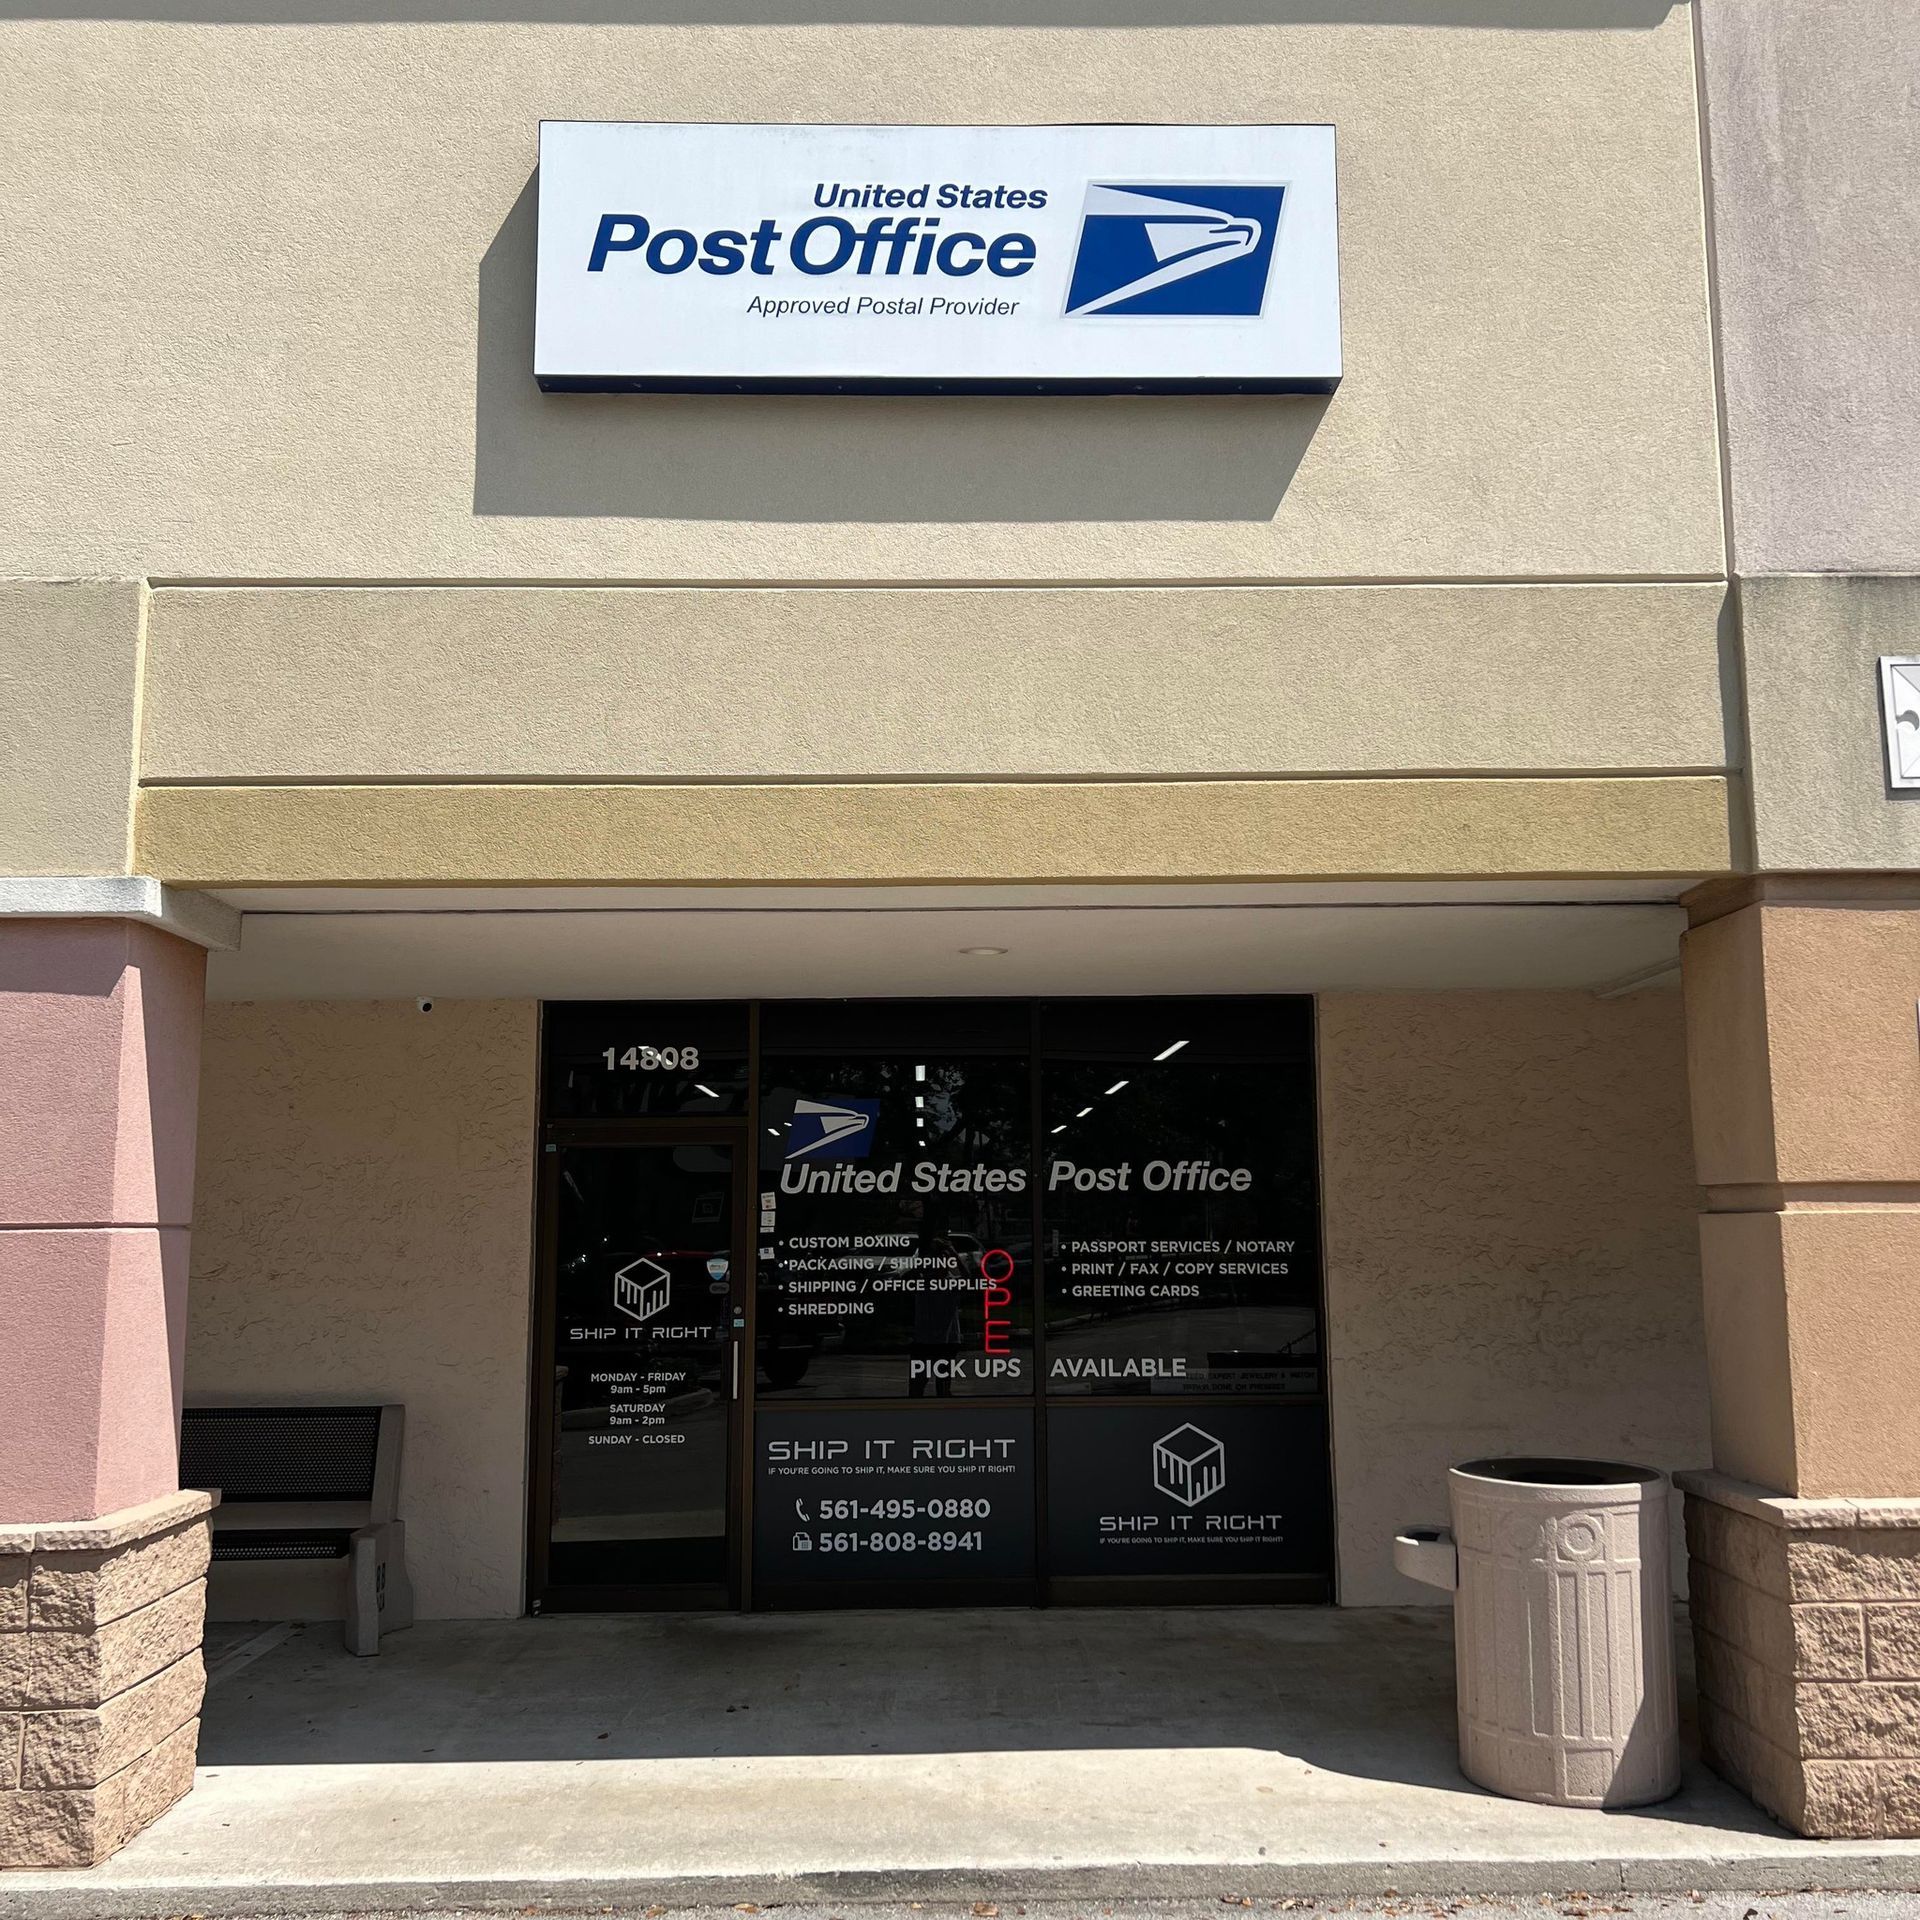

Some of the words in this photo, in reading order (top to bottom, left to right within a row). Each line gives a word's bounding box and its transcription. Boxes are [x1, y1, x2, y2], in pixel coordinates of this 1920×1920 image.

[814, 184, 930, 208] United
[937, 184, 1048, 209] States
[587, 214, 782, 275] Post
[790, 216, 1036, 277] Office
[747, 296, 850, 317] Approved
[857, 297, 923, 314] Postal
[930, 298, 1020, 315] Provider
[603, 1046, 698, 1070] 14808
[781, 1163, 902, 1194] United
[912, 1162, 1026, 1192] States
[1049, 1161, 1131, 1191] Post
[1143, 1161, 1252, 1191] Office
[789, 1237, 849, 1248] CUSTOM
[854, 1235, 910, 1248] BOXING
[1072, 1241, 1146, 1252] PASSPORT
[1151, 1241, 1220, 1252] SERVICES
[1237, 1241, 1294, 1252] NOTARY
[788, 1258, 874, 1271] PACKAGING
[890, 1257, 958, 1269] SHIPPING
[1072, 1264, 1114, 1274] PRINT
[1131, 1263, 1158, 1274] FAX
[1175, 1263, 1214, 1274] COPY
[1219, 1263, 1288, 1274] SERVICES
[789, 1281, 856, 1292] SHIPPING
[873, 1280, 925, 1291] OFFICE
[929, 1279, 997, 1291] SUPPLIES
[1072, 1285, 1145, 1296] GREETING
[1150, 1285, 1199, 1296] CARDS
[789, 1303, 874, 1315] SHREDDING
[570, 1328, 616, 1339] SHIP
[626, 1328, 642, 1338] IT
[653, 1327, 711, 1338] RIGHT
[911, 1359, 966, 1378] PICK
[975, 1358, 1020, 1377] UPS
[1050, 1358, 1186, 1377] AVAILABLE
[591, 1373, 638, 1382] MONDAY
[648, 1373, 686, 1381] FRIDAY
[611, 1385, 632, 1393] 9am
[643, 1385, 665, 1394] 5pm
[610, 1404, 665, 1413] SATURDAY
[610, 1416, 631, 1424] 9am
[642, 1416, 664, 1426] 2pm
[589, 1436, 632, 1444] SUNDAY
[643, 1435, 685, 1443] CLOSED
[769, 1441, 848, 1460] SHIP
[866, 1440, 895, 1459] IT
[913, 1440, 1015, 1458] RIGHT
[876, 1466, 885, 1474] IT,
[820, 1499, 990, 1519] 561-495-0880
[1100, 1516, 1158, 1531] SHIP
[1171, 1516, 1192, 1530] IT
[1206, 1515, 1281, 1530] RIGHT
[819, 1531, 981, 1552] 561-808-8941
